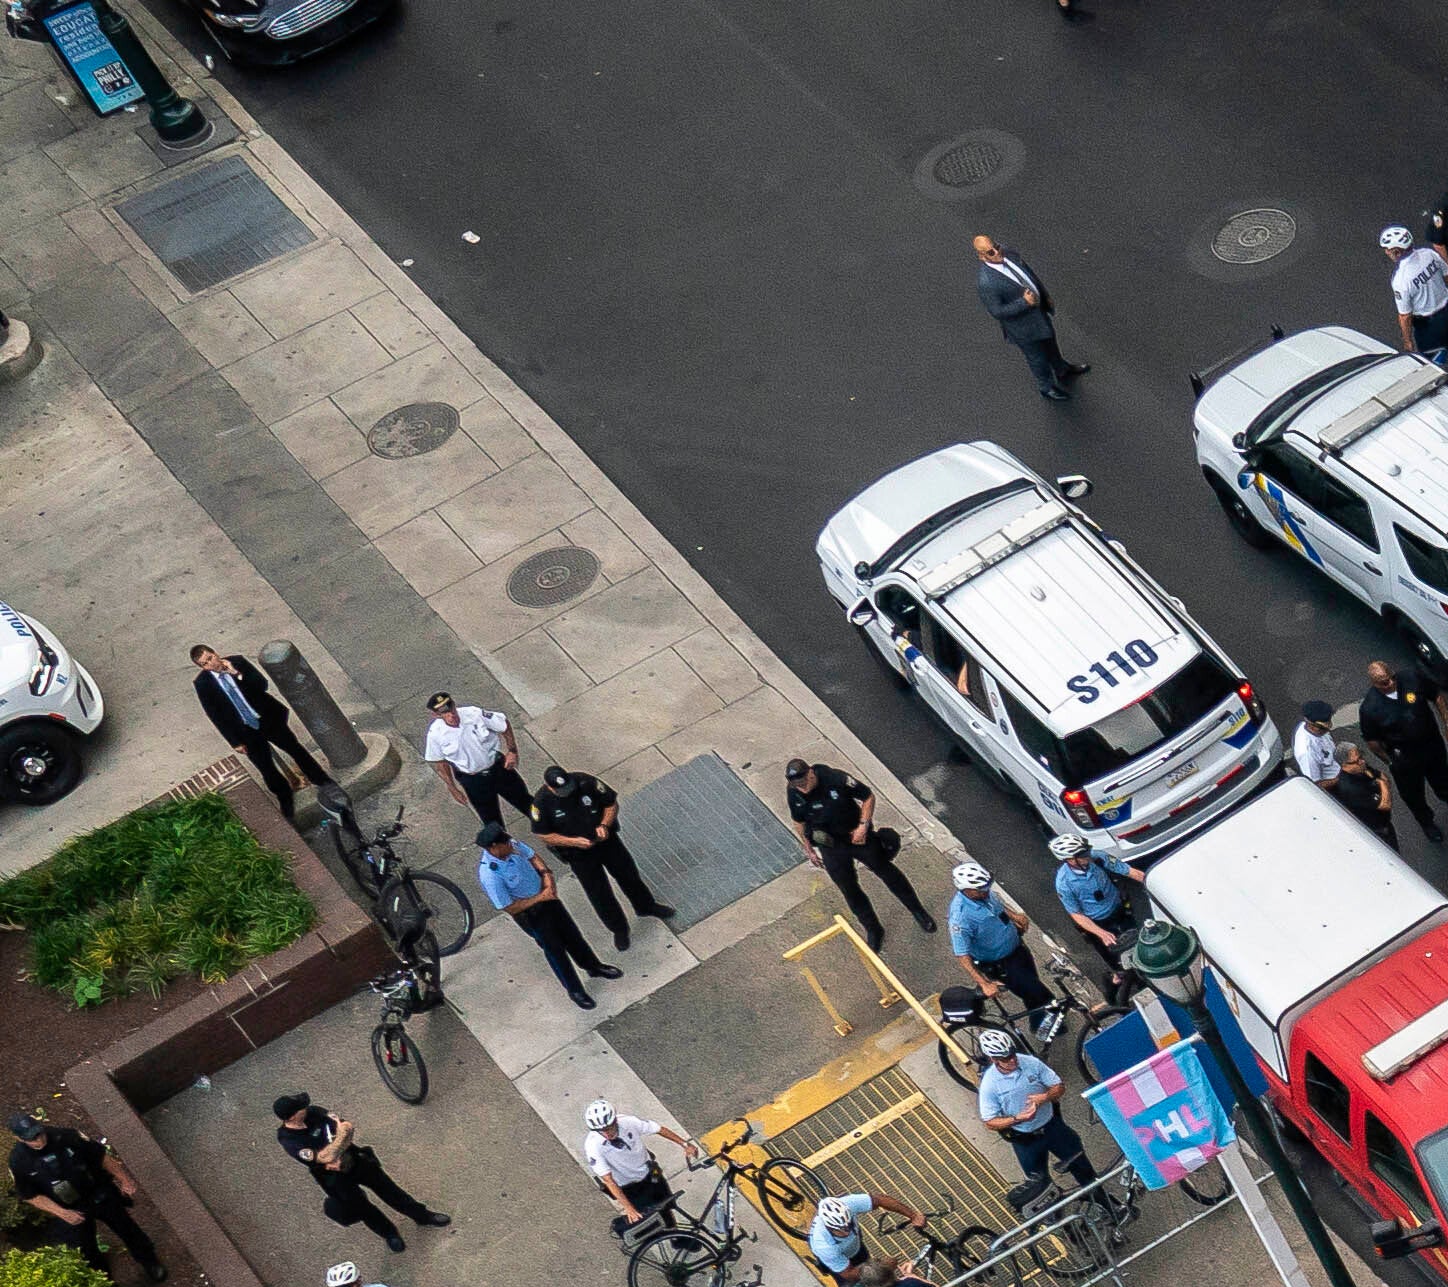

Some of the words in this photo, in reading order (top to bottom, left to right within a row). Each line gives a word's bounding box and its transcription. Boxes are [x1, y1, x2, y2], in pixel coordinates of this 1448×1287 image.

[53, 12, 97, 35] EDUCAT
[1412, 259, 1439, 289] POLICE
[1067, 640, 1156, 704] S110
[1124, 1104, 1207, 1152] PHL
